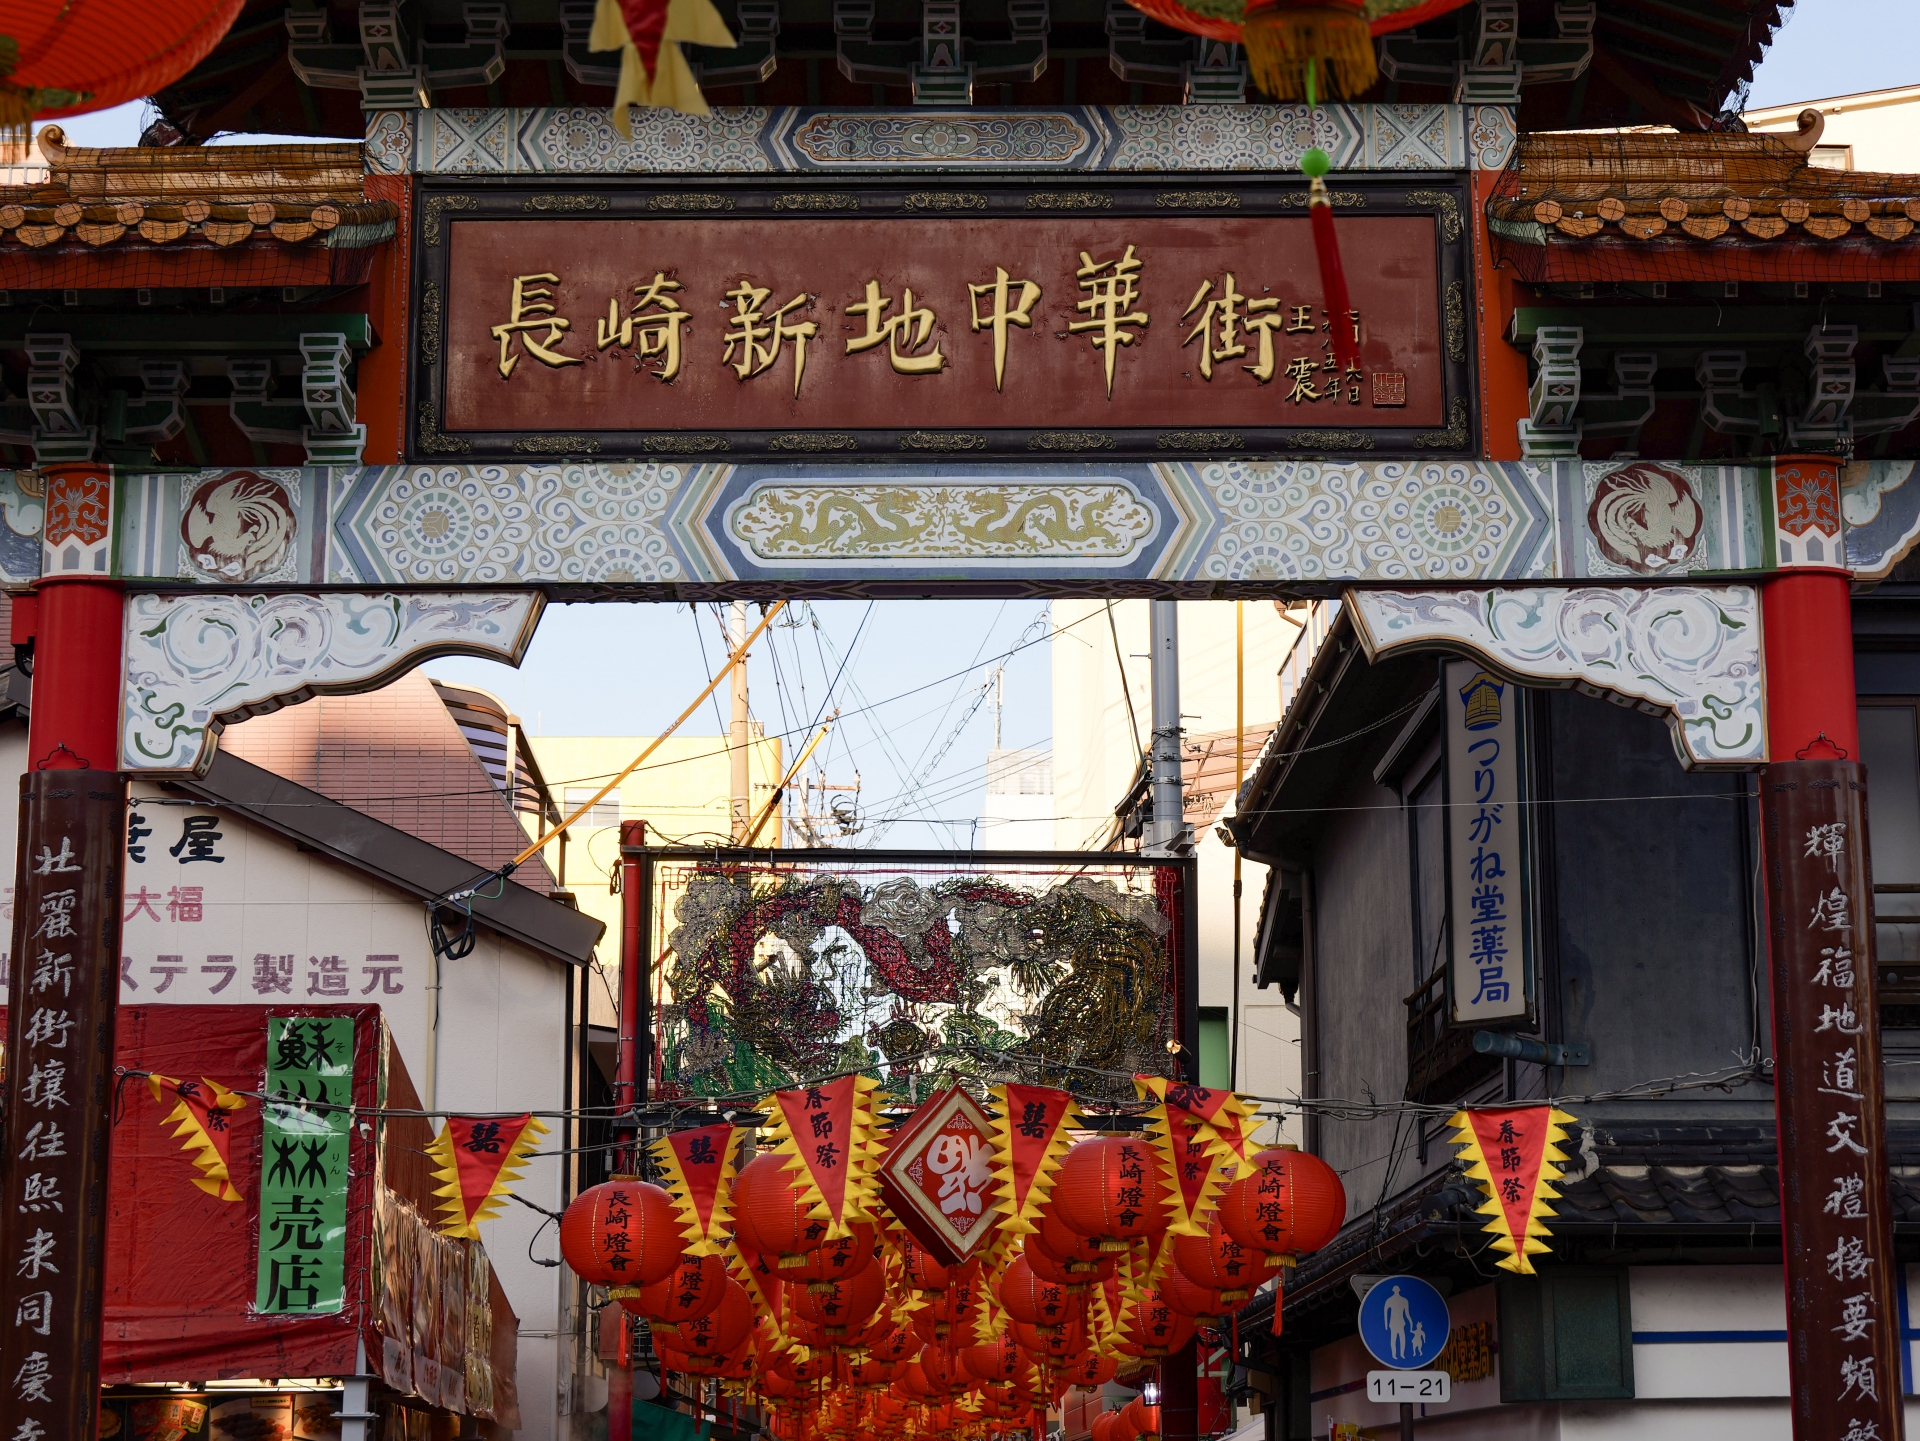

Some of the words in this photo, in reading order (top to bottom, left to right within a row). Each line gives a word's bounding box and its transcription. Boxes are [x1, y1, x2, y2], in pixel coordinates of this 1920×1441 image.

[490, 243, 1281, 400] 長崎新地中華街
[1468, 738, 1509, 1005] つりがね堂薬局
[804, 1087, 840, 1168] 春節祭
[1496, 1119, 1525, 1203] 春節祭
[1115, 1146, 1146, 1227] 長崎燈會
[1255, 1160, 1286, 1242] 長崎燈會
[603, 1190, 635, 1271] 長崎燈會
[1373, 1378, 1443, 1396] 11-21
